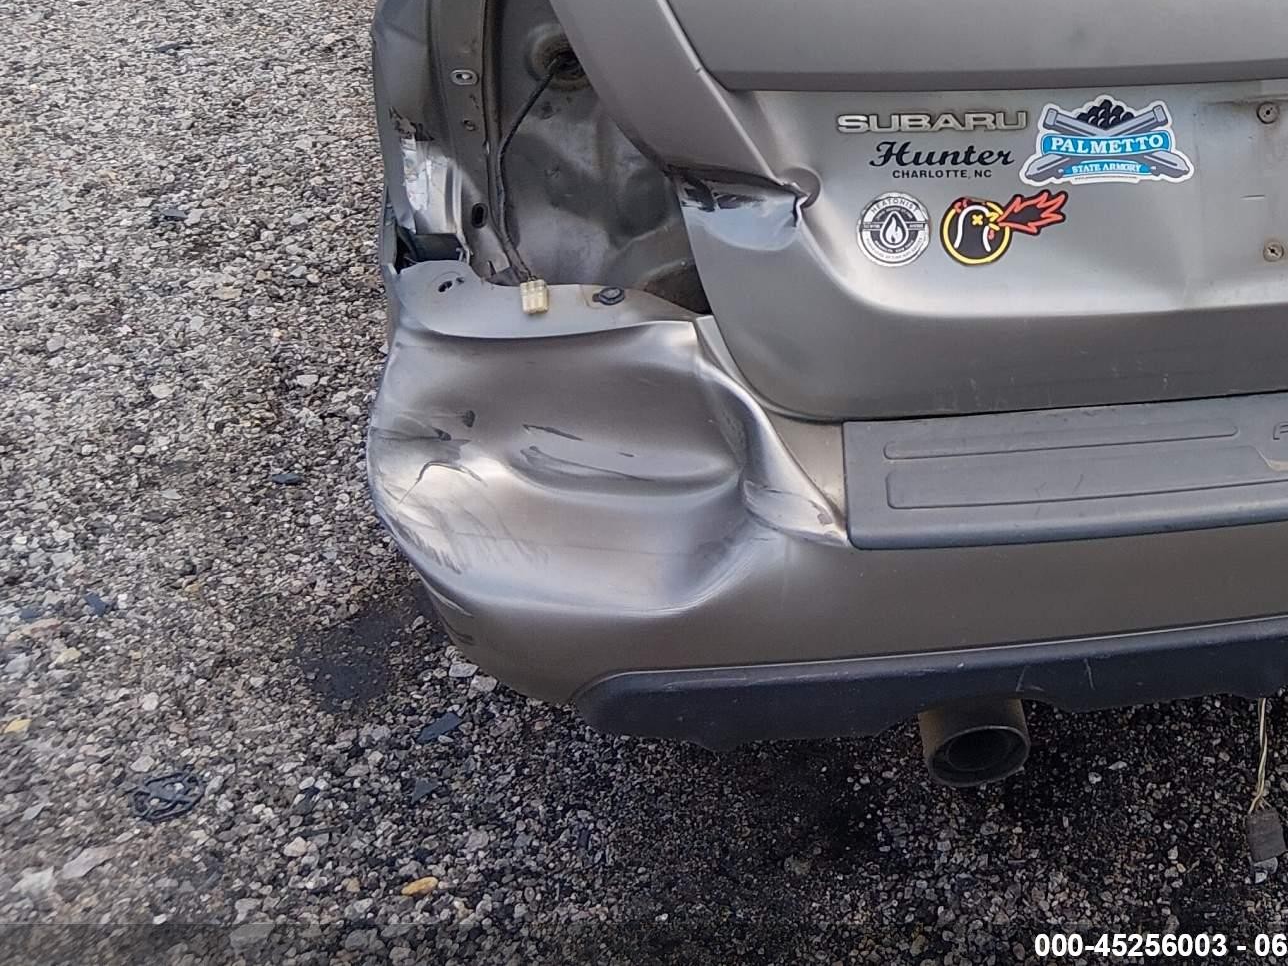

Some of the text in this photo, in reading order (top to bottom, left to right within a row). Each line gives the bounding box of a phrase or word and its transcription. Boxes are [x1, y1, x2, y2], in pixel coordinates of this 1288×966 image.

[837, 110, 1027, 133] SUBARU
[869, 140, 1015, 167] Hunter
[1051, 134, 1164, 154] PALMETTO
[892, 169, 993, 180] CHARLOTTE, NC
[1072, 163, 1142, 173] STATE ARMORY
